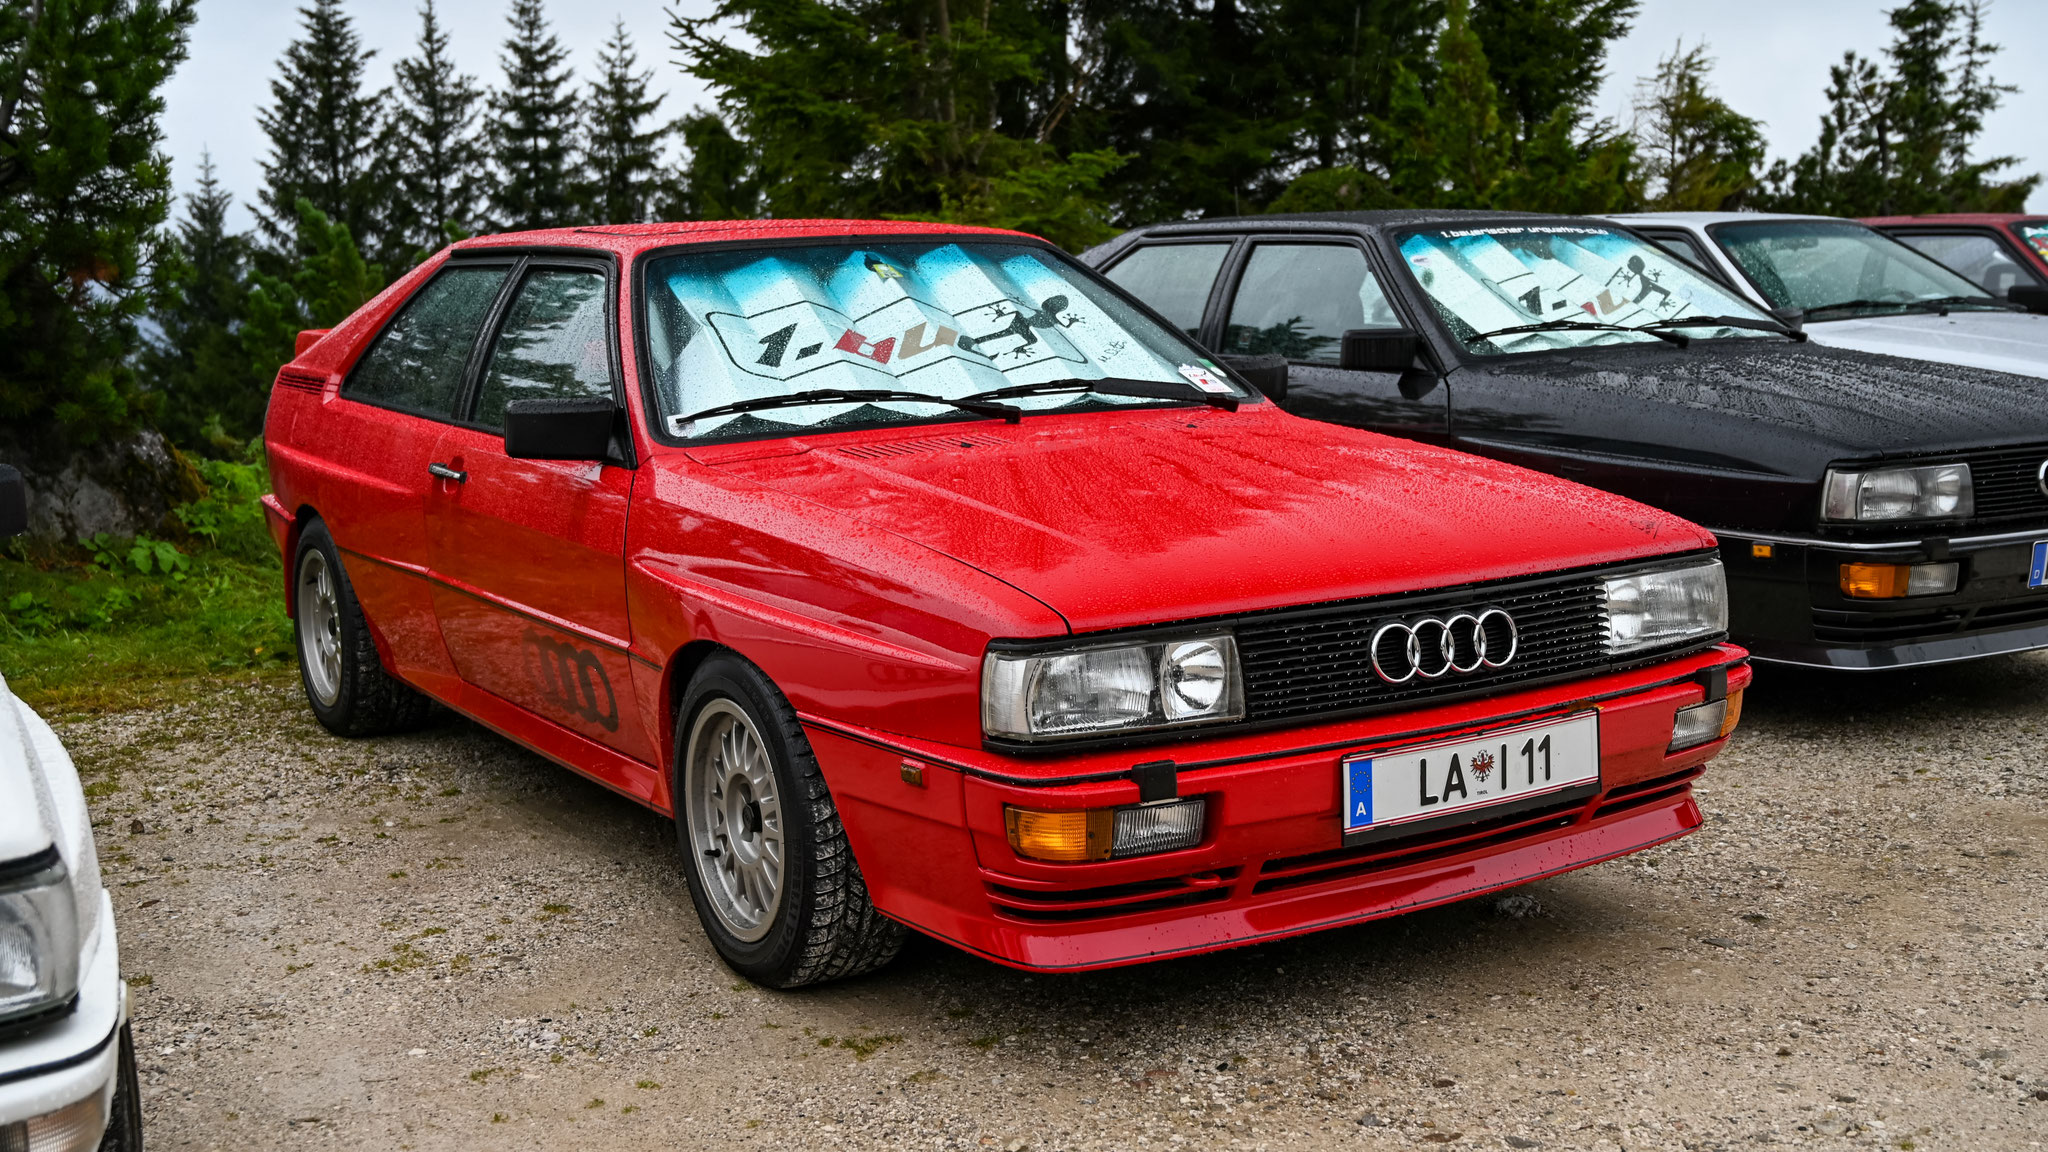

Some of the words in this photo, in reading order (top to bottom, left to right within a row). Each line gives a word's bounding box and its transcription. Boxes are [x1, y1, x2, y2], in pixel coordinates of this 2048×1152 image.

[2033, 569, 2041, 579] D
[1419, 752, 1468, 807] LA
[1355, 801, 1367, 818] A
